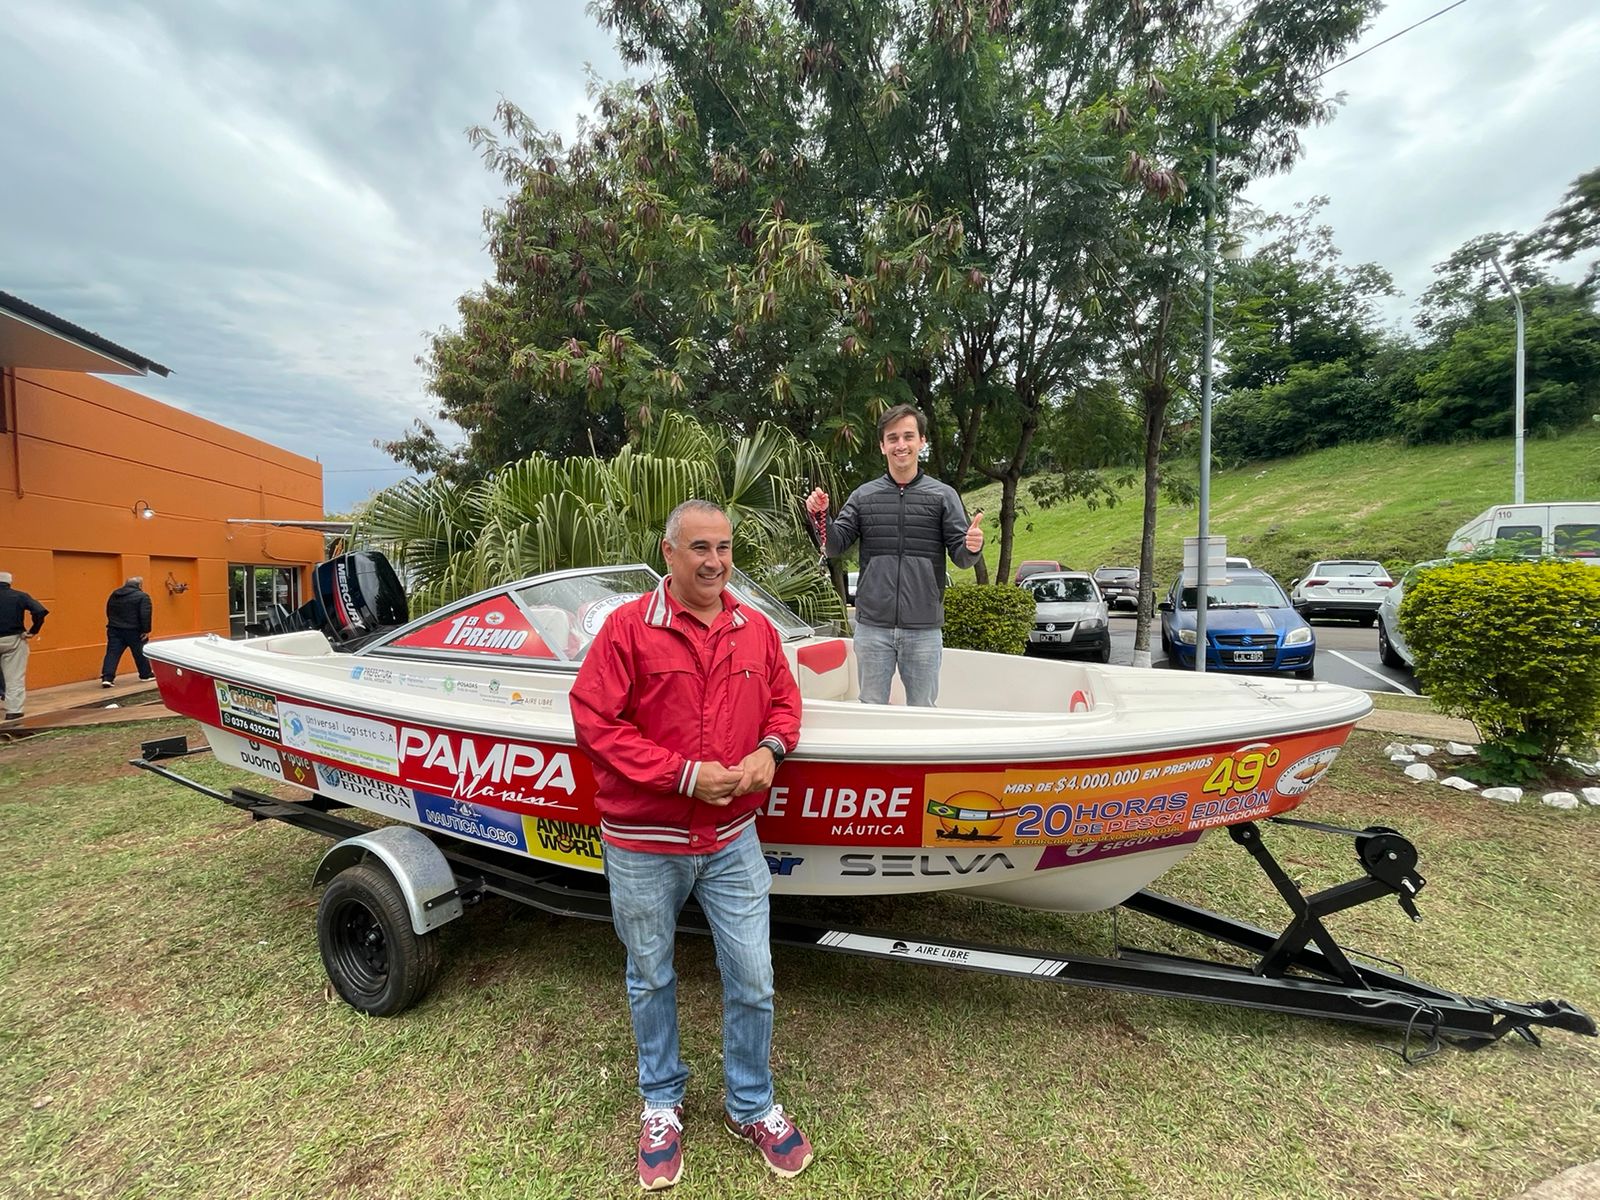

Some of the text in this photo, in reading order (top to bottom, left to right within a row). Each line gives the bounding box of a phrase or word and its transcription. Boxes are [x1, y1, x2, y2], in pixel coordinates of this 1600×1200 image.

[1498, 511, 1512, 519] 110
[337, 563, 367, 629] MERCURY
[443, 615, 480, 645] 1ER
[586, 609, 598, 629] CLUB
[457, 627, 530, 650] PREMIO
[220, 689, 228, 702] B
[457, 680, 479, 689] POSADAS
[230, 690, 277, 717] GARCIA
[524, 697, 553, 707] AIRE LIBRE
[231, 717, 249, 730] 0376
[249, 723, 280, 740] 4352274
[305, 715, 340, 731] Universal
[342, 724, 378, 740] Logistic
[379, 731, 397, 744] S.A.
[398, 727, 577, 797] PAMPA
[1004, 756, 1215, 794] MAS DE $4.000.000 EN PREMIOS
[339, 771, 408, 799] PRIMERA
[342, 779, 412, 809] EDICION
[801, 787, 913, 819] LIBRE
[1014, 791, 1190, 838] 20 HORAS
[1190, 786, 1274, 821] EDICIÓN
[425, 809, 519, 847] NAUTICA LOBO
[536, 817, 602, 843] ANIMA
[831, 824, 905, 836] NÁUTICA
[1073, 810, 1188, 836] DE PESCA
[1187, 805, 1271, 830] INTERNACIONAL
[537, 832, 603, 859] WORL
[839, 852, 1015, 877] SELVA
[915, 945, 970, 960] AIRE LIBRE
